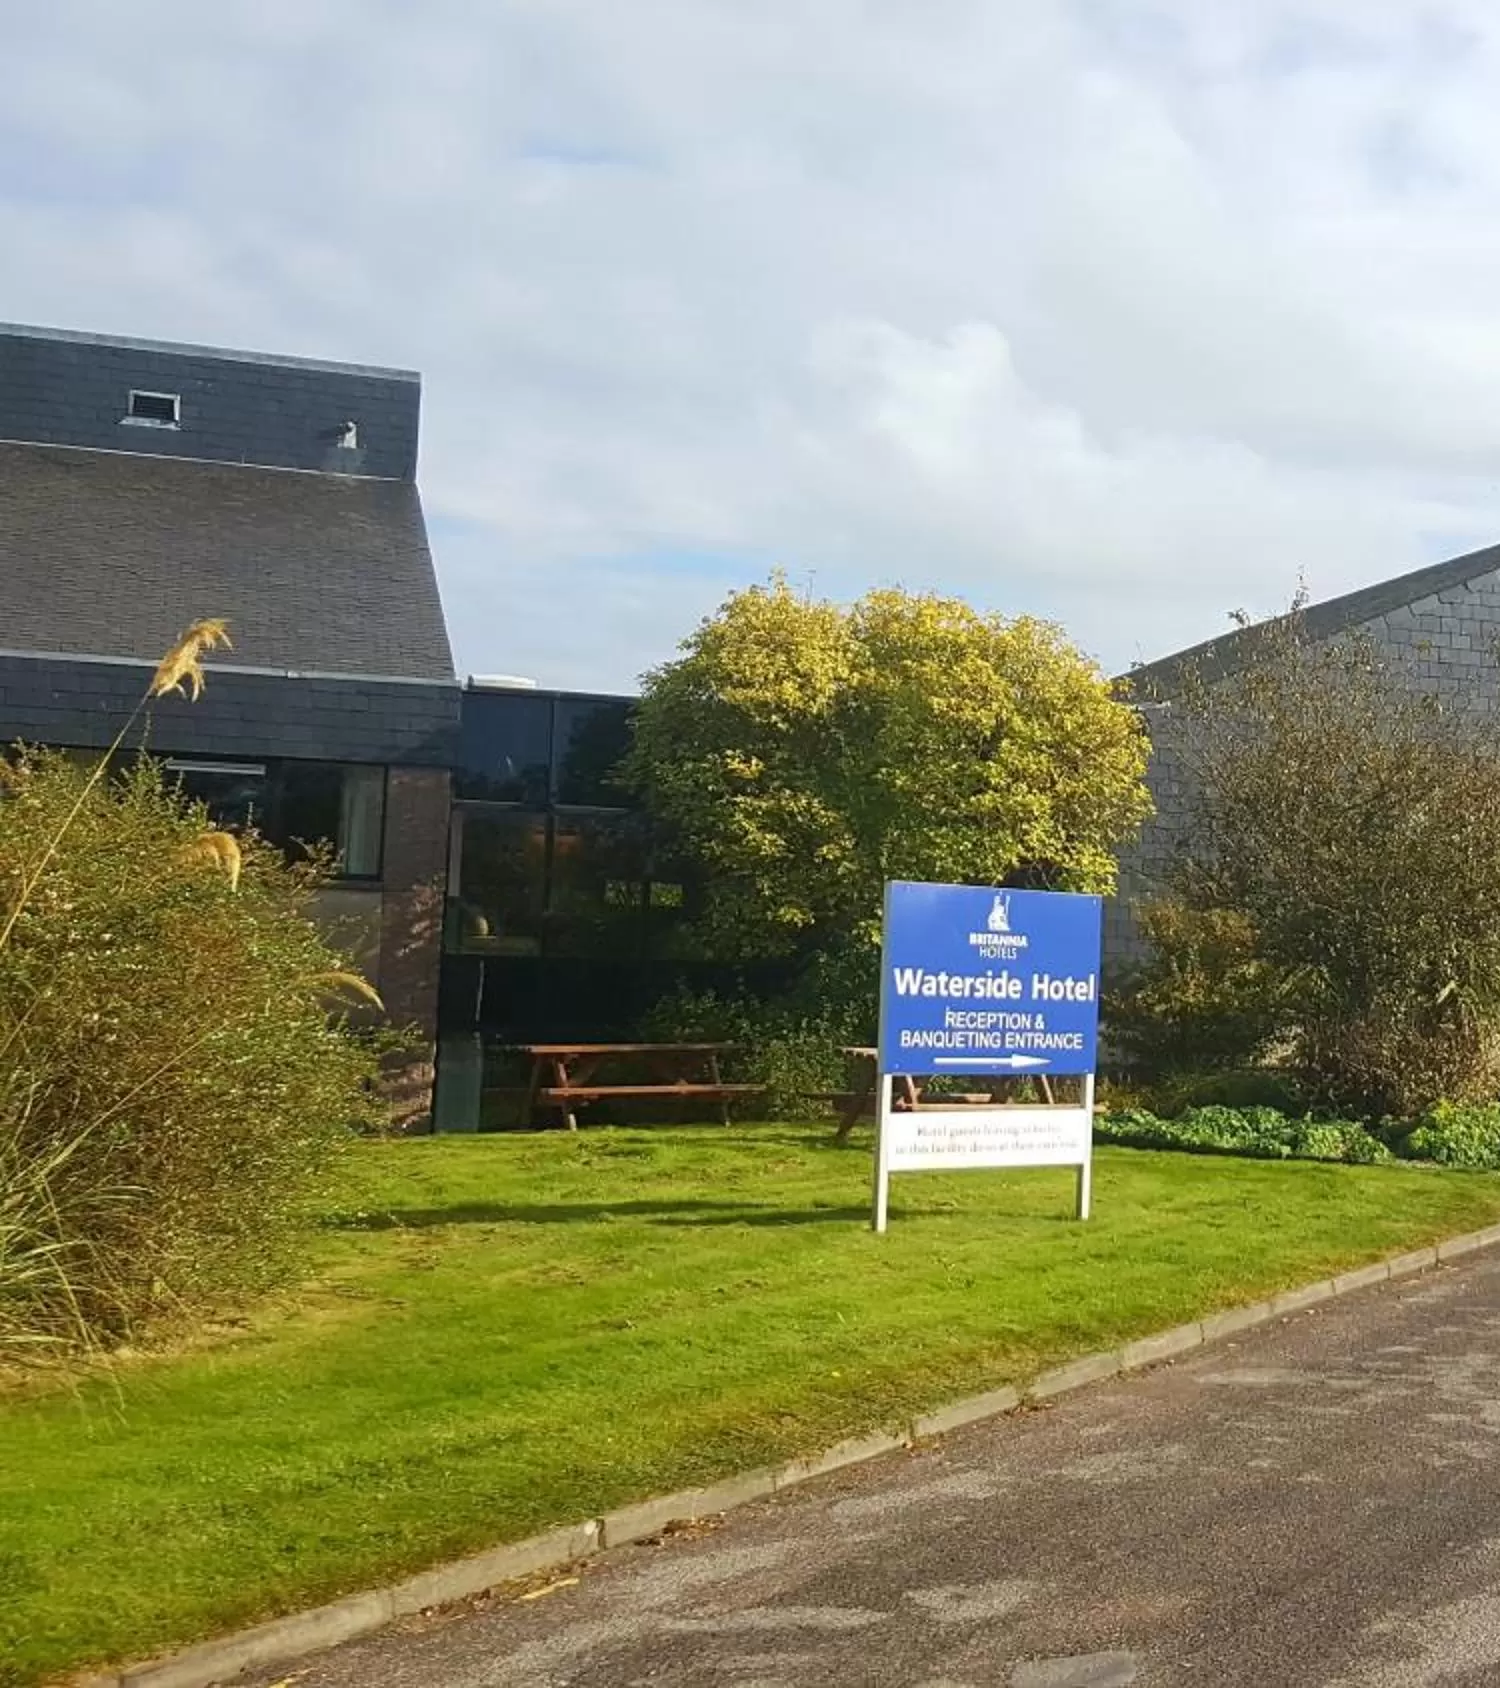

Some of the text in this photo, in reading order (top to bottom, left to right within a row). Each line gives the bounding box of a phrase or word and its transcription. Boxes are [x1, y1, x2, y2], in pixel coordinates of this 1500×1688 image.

[969, 932, 1028, 947] BRITANNIA
[979, 946, 1017, 960] HOTELS
[893, 967, 1095, 1001] Waterside Hotel
[945, 1009, 1045, 1030] RECEPTION &
[901, 1030, 1083, 1049] BANQUETING ENTRANCE
